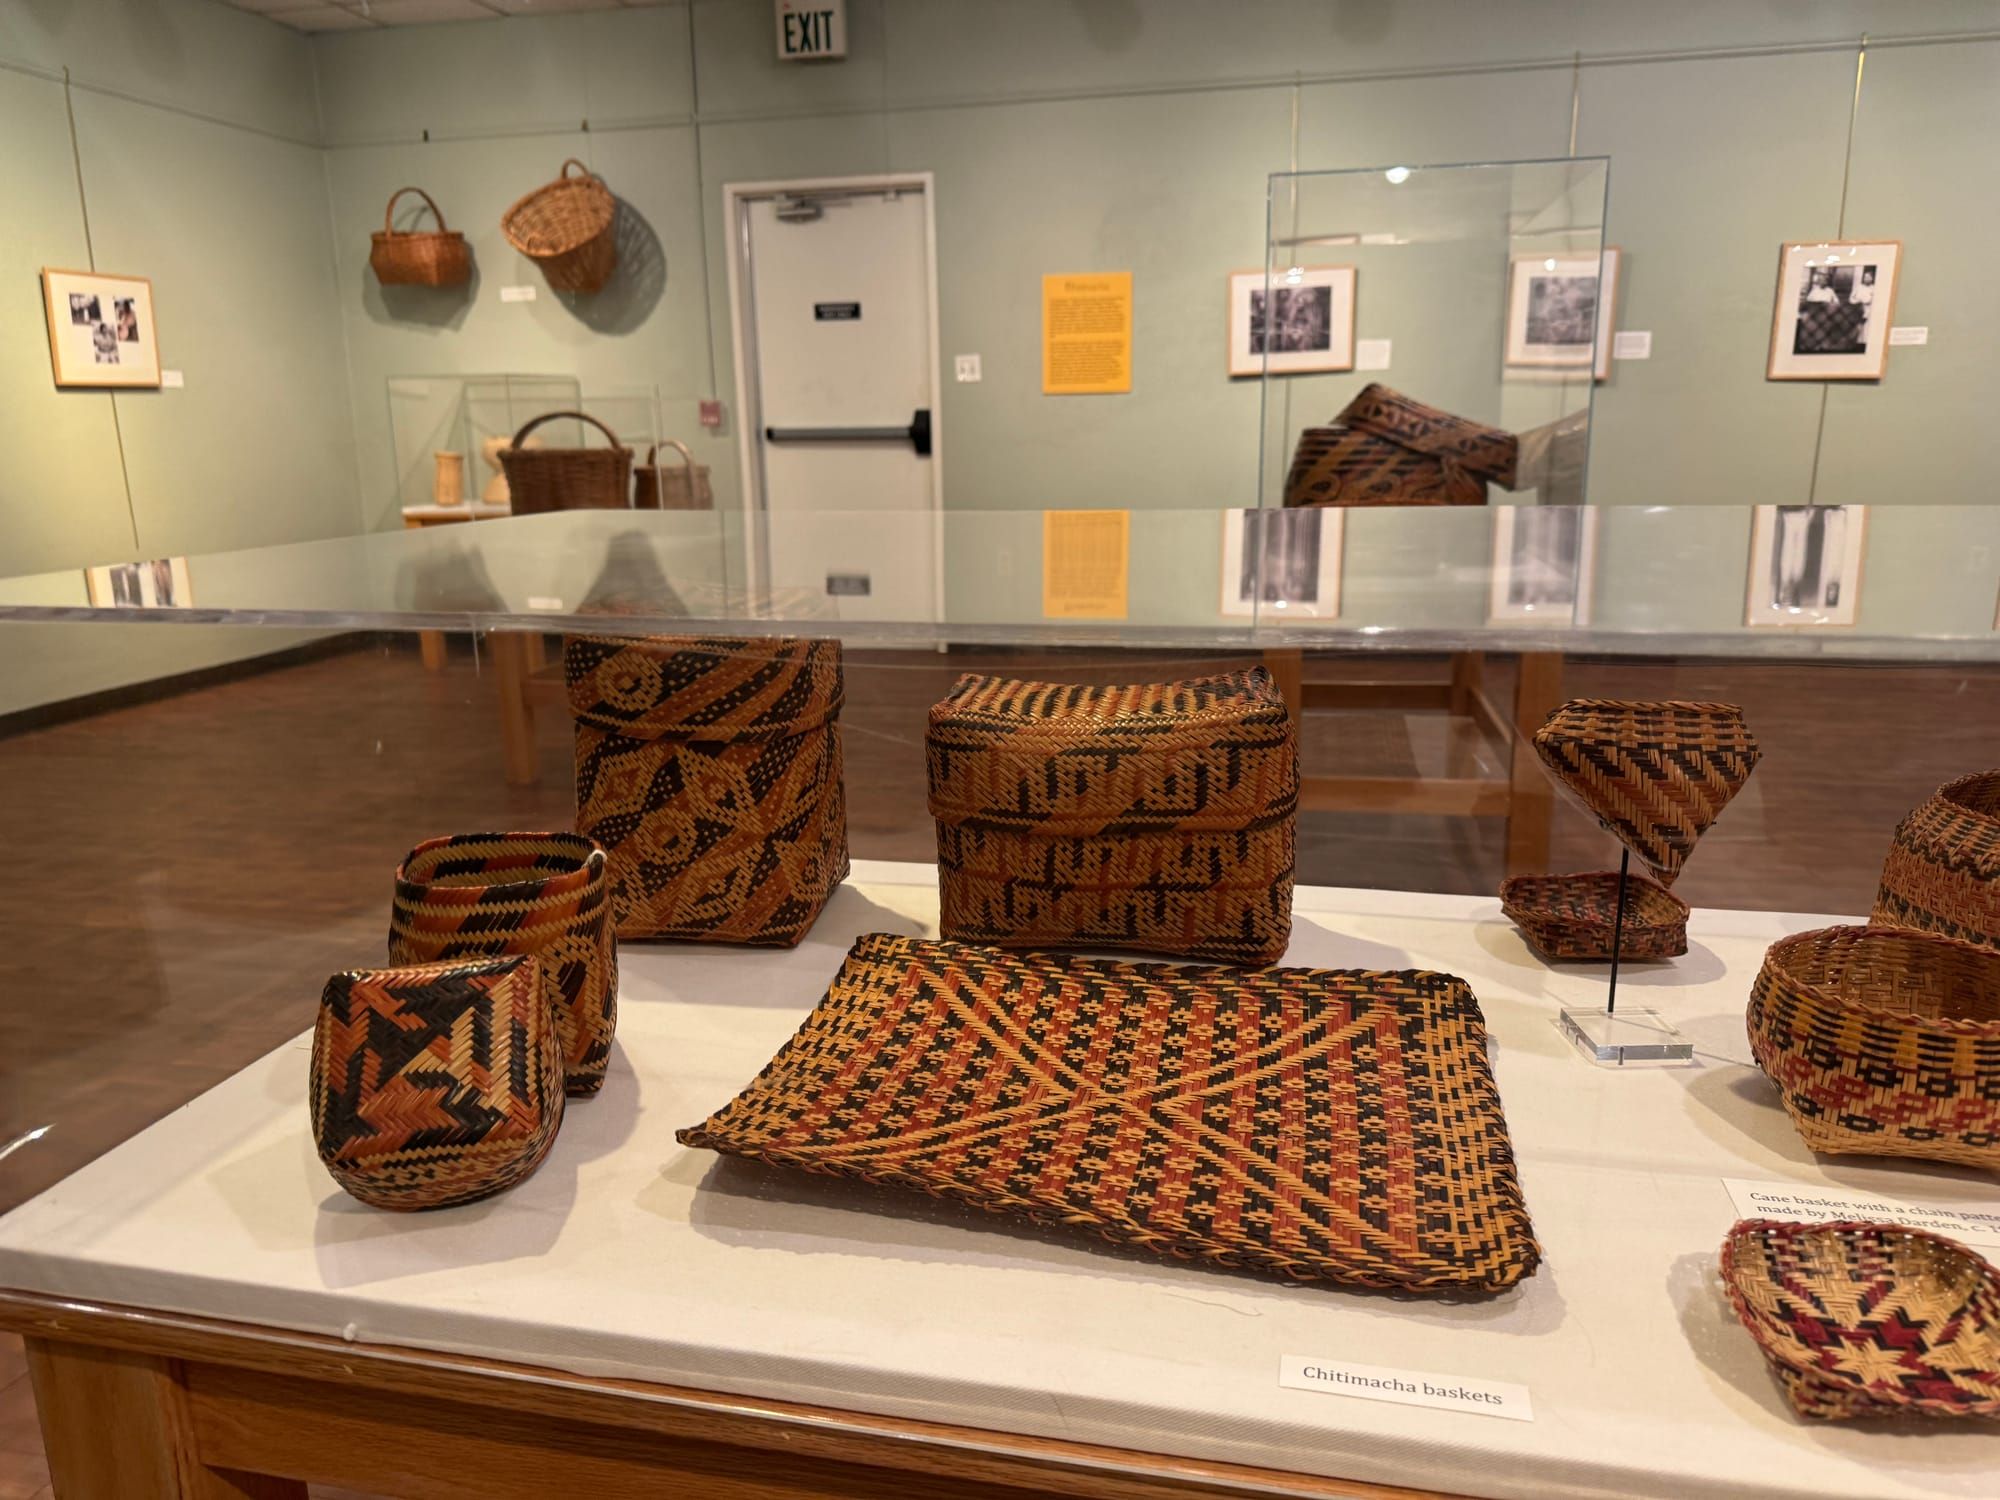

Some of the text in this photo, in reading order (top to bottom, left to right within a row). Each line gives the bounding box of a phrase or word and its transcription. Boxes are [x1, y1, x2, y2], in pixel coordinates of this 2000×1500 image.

[783, 10, 834, 53] EXIT
[1750, 1192, 1790, 1203] Cane
[1793, 1196, 1849, 1209] basket
[1852, 1202, 1891, 1213] with
[1909, 1207, 1955, 1218] chain
[1757, 1206, 1802, 1216] made
[1805, 1208, 1827, 1219] by
[1830, 1211, 1893, 1223] Melissa
[1303, 1366, 1503, 1405] Chitimacha baskets
